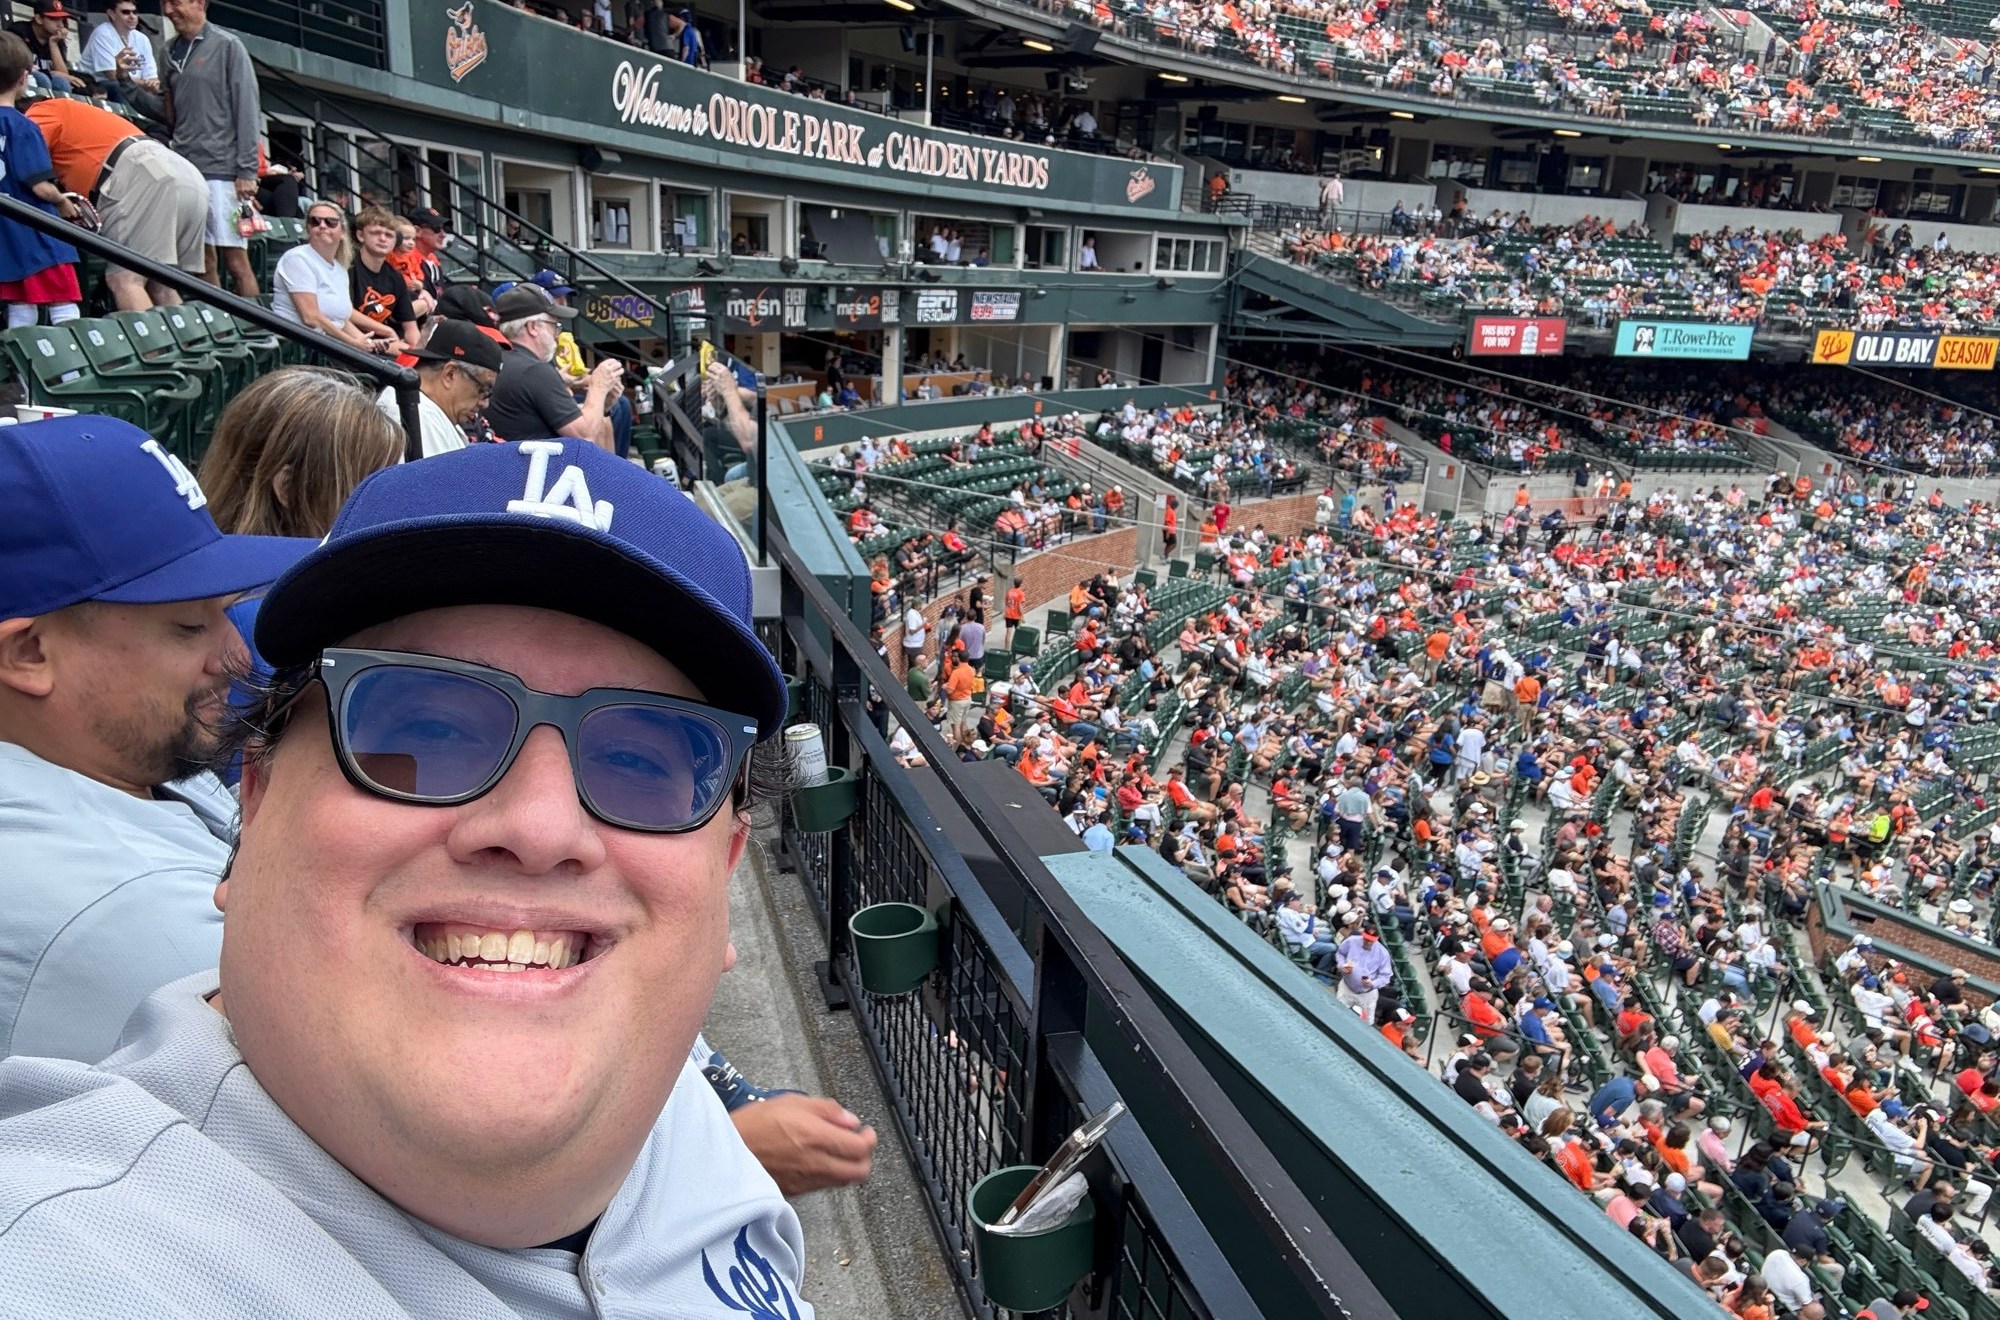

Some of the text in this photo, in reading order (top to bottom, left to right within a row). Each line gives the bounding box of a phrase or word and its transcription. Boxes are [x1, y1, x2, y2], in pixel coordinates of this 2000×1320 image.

[612, 60, 1050, 190] Welcome to ORIOLE PARK at CAMDEN YARDS
[726, 294, 782, 322] masn
[1481, 325, 1516, 337] THIS BUD'S
[1483, 336, 1511, 348] FOR YOU
[1855, 335, 1895, 363] OLD
[1940, 340, 1993, 365] SEASON
[506, 441, 614, 533] LA
